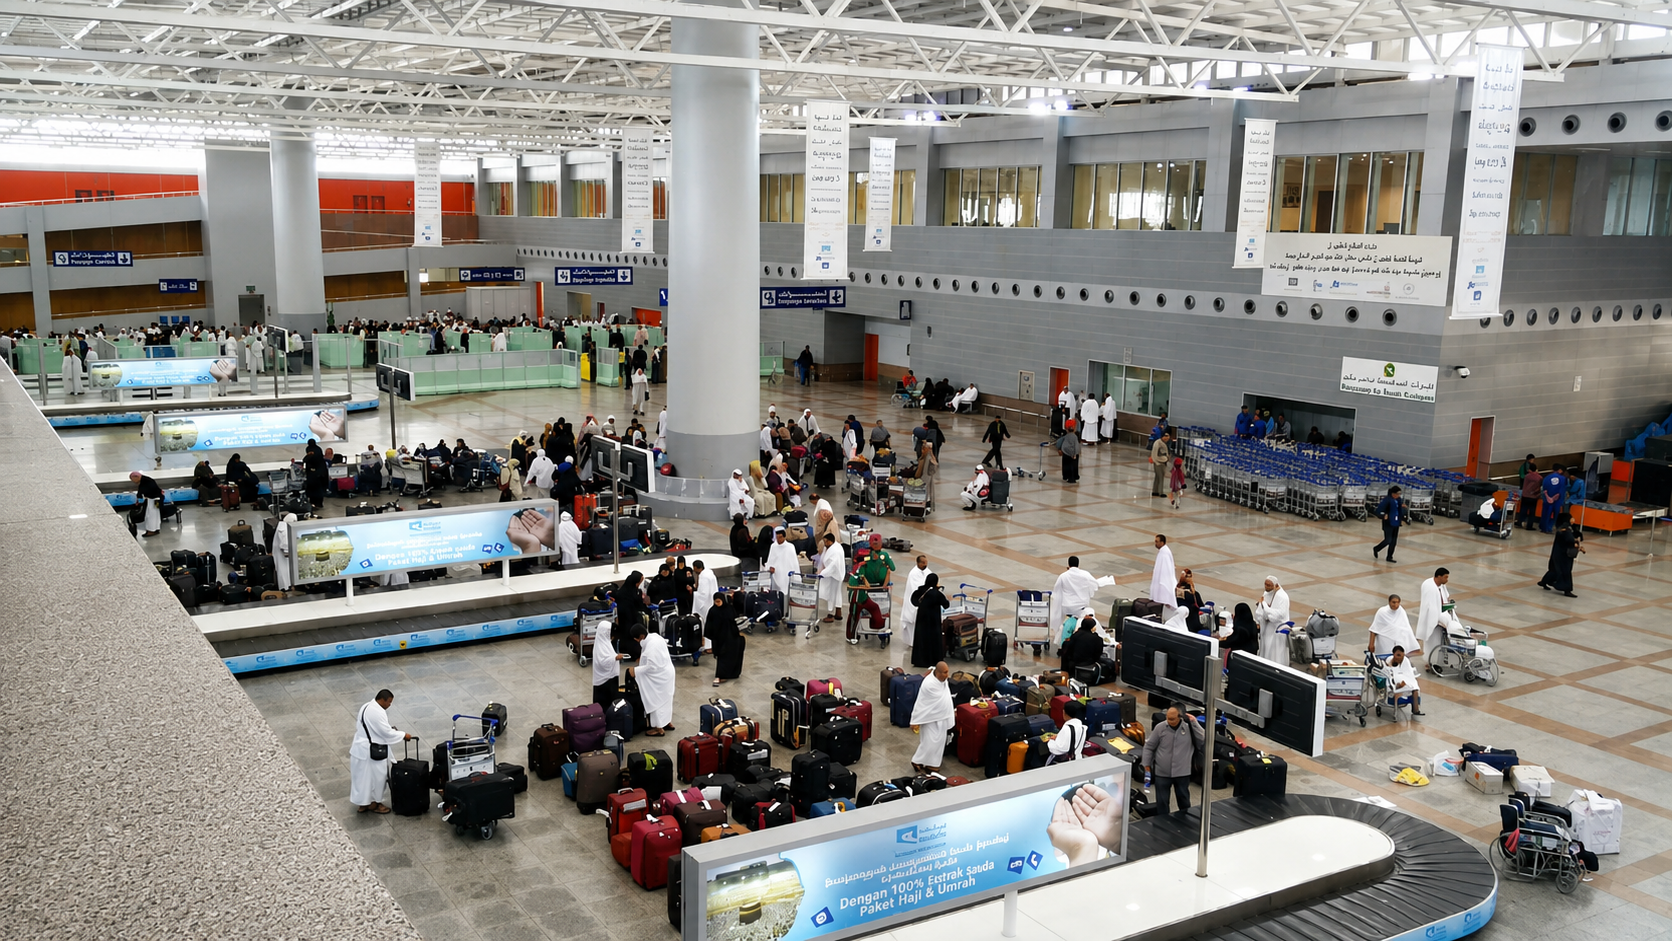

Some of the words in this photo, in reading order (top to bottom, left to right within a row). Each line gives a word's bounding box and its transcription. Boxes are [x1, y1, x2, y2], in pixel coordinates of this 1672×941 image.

[840, 889, 888, 910] Dengan
[891, 878, 924, 895] 100%
[966, 860, 994, 876] Sauda
[860, 898, 895, 917] Paket
[925, 886, 935, 898] &
[938, 875, 976, 895] Umrah
